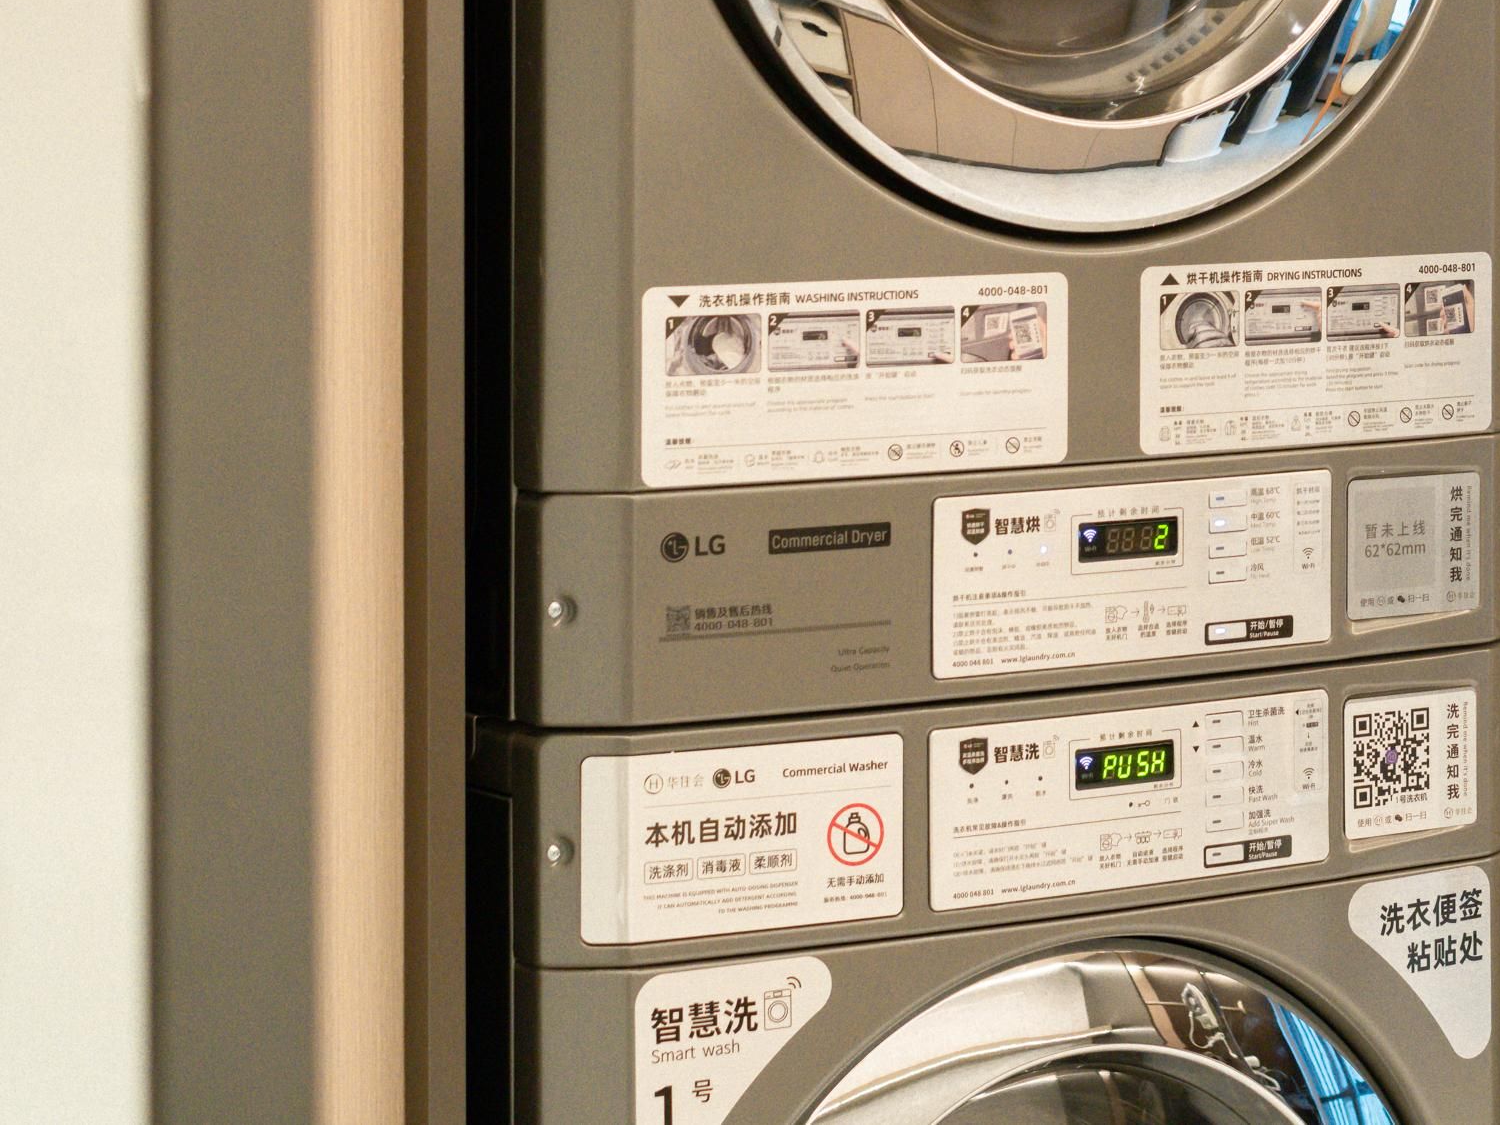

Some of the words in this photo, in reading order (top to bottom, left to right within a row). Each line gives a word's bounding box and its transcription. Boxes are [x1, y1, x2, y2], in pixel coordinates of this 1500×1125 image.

[1186, 270, 1263, 285] 烘干机操作指南
[1267, 271, 1300, 282] DRYING
[1301, 268, 1363, 281] INSTRUCTIONS
[1418, 263, 1476, 274] 4000-048-801
[698, 292, 791, 308] 洗衣机操作指南
[795, 292, 845, 304] WASHING
[847, 289, 919, 302] INSTRUCTIONS
[978, 285, 1048, 297] 4000-048-801
[1246, 291, 1253, 302] 2
[1328, 287, 1334, 298] 3
[769, 316, 777, 326] 2
[868, 312, 875, 322] 3
[962, 308, 970, 318] 4
[995, 516, 1041, 535] 智慧烘
[1365, 520, 1426, 540] 暂未上线
[1449, 486, 1463, 583] 烘完通知我
[694, 534, 726, 556] LG
[771, 531, 848, 550] Commercial
[851, 528, 888, 544] Dryer
[1250, 618, 1284, 630] 开始/暂停
[1248, 734, 1263, 744] 温水
[994, 743, 1040, 764] 智慧洗
[1446, 703, 1460, 801] 洗完通知我
[782, 763, 847, 779] Commercial
[848, 760, 889, 773] Washer
[1102, 750, 1166, 780] PUSH
[1248, 760, 1263, 769] 冷水
[734, 769, 756, 784] LG
[644, 811, 798, 848] 本机自动添加
[1248, 840, 1282, 853] 开始/暂停
[701, 857, 742, 874] 消毒液
[753, 853, 793, 870] 柔顺剂
[648, 862, 690, 880] 洗涤剂
[1001, 879, 1076, 895] www.lglaundry.com.cn
[1379, 888, 1483, 937] 洗衣便签
[1406, 930, 1483, 974] 粘贴处
[650, 996, 759, 1045] 智慧洗
[650, 1045, 696, 1065] Smart
[702, 1039, 740, 1057] wash
[692, 1078, 714, 1103] 号
